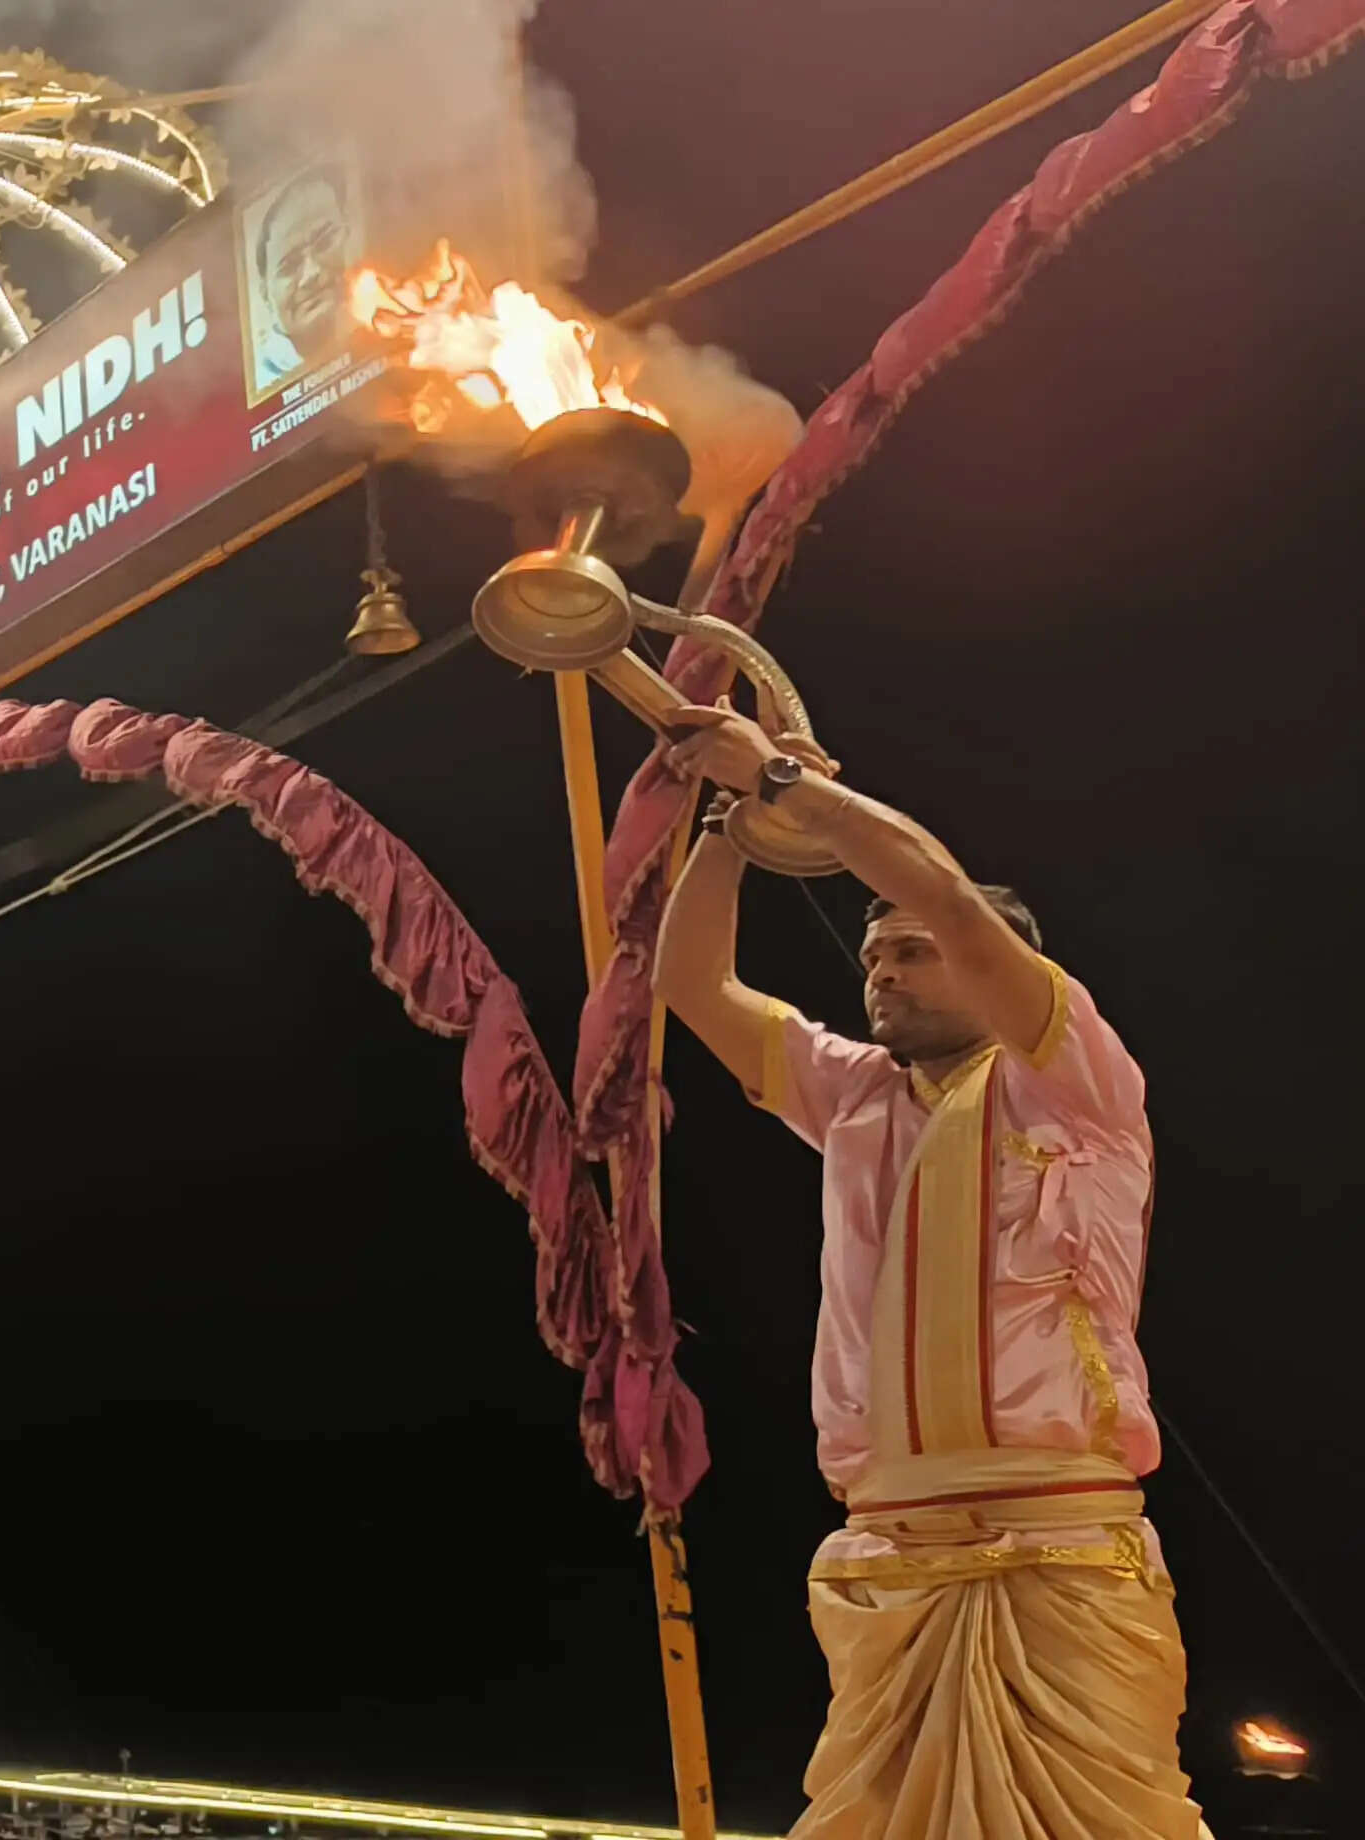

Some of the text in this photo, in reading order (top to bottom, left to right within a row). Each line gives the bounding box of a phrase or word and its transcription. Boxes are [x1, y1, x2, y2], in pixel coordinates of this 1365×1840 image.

[25, 457, 70, 497] our
[82, 412, 147, 459] life.
[9, 462, 157, 583] VARANASI
